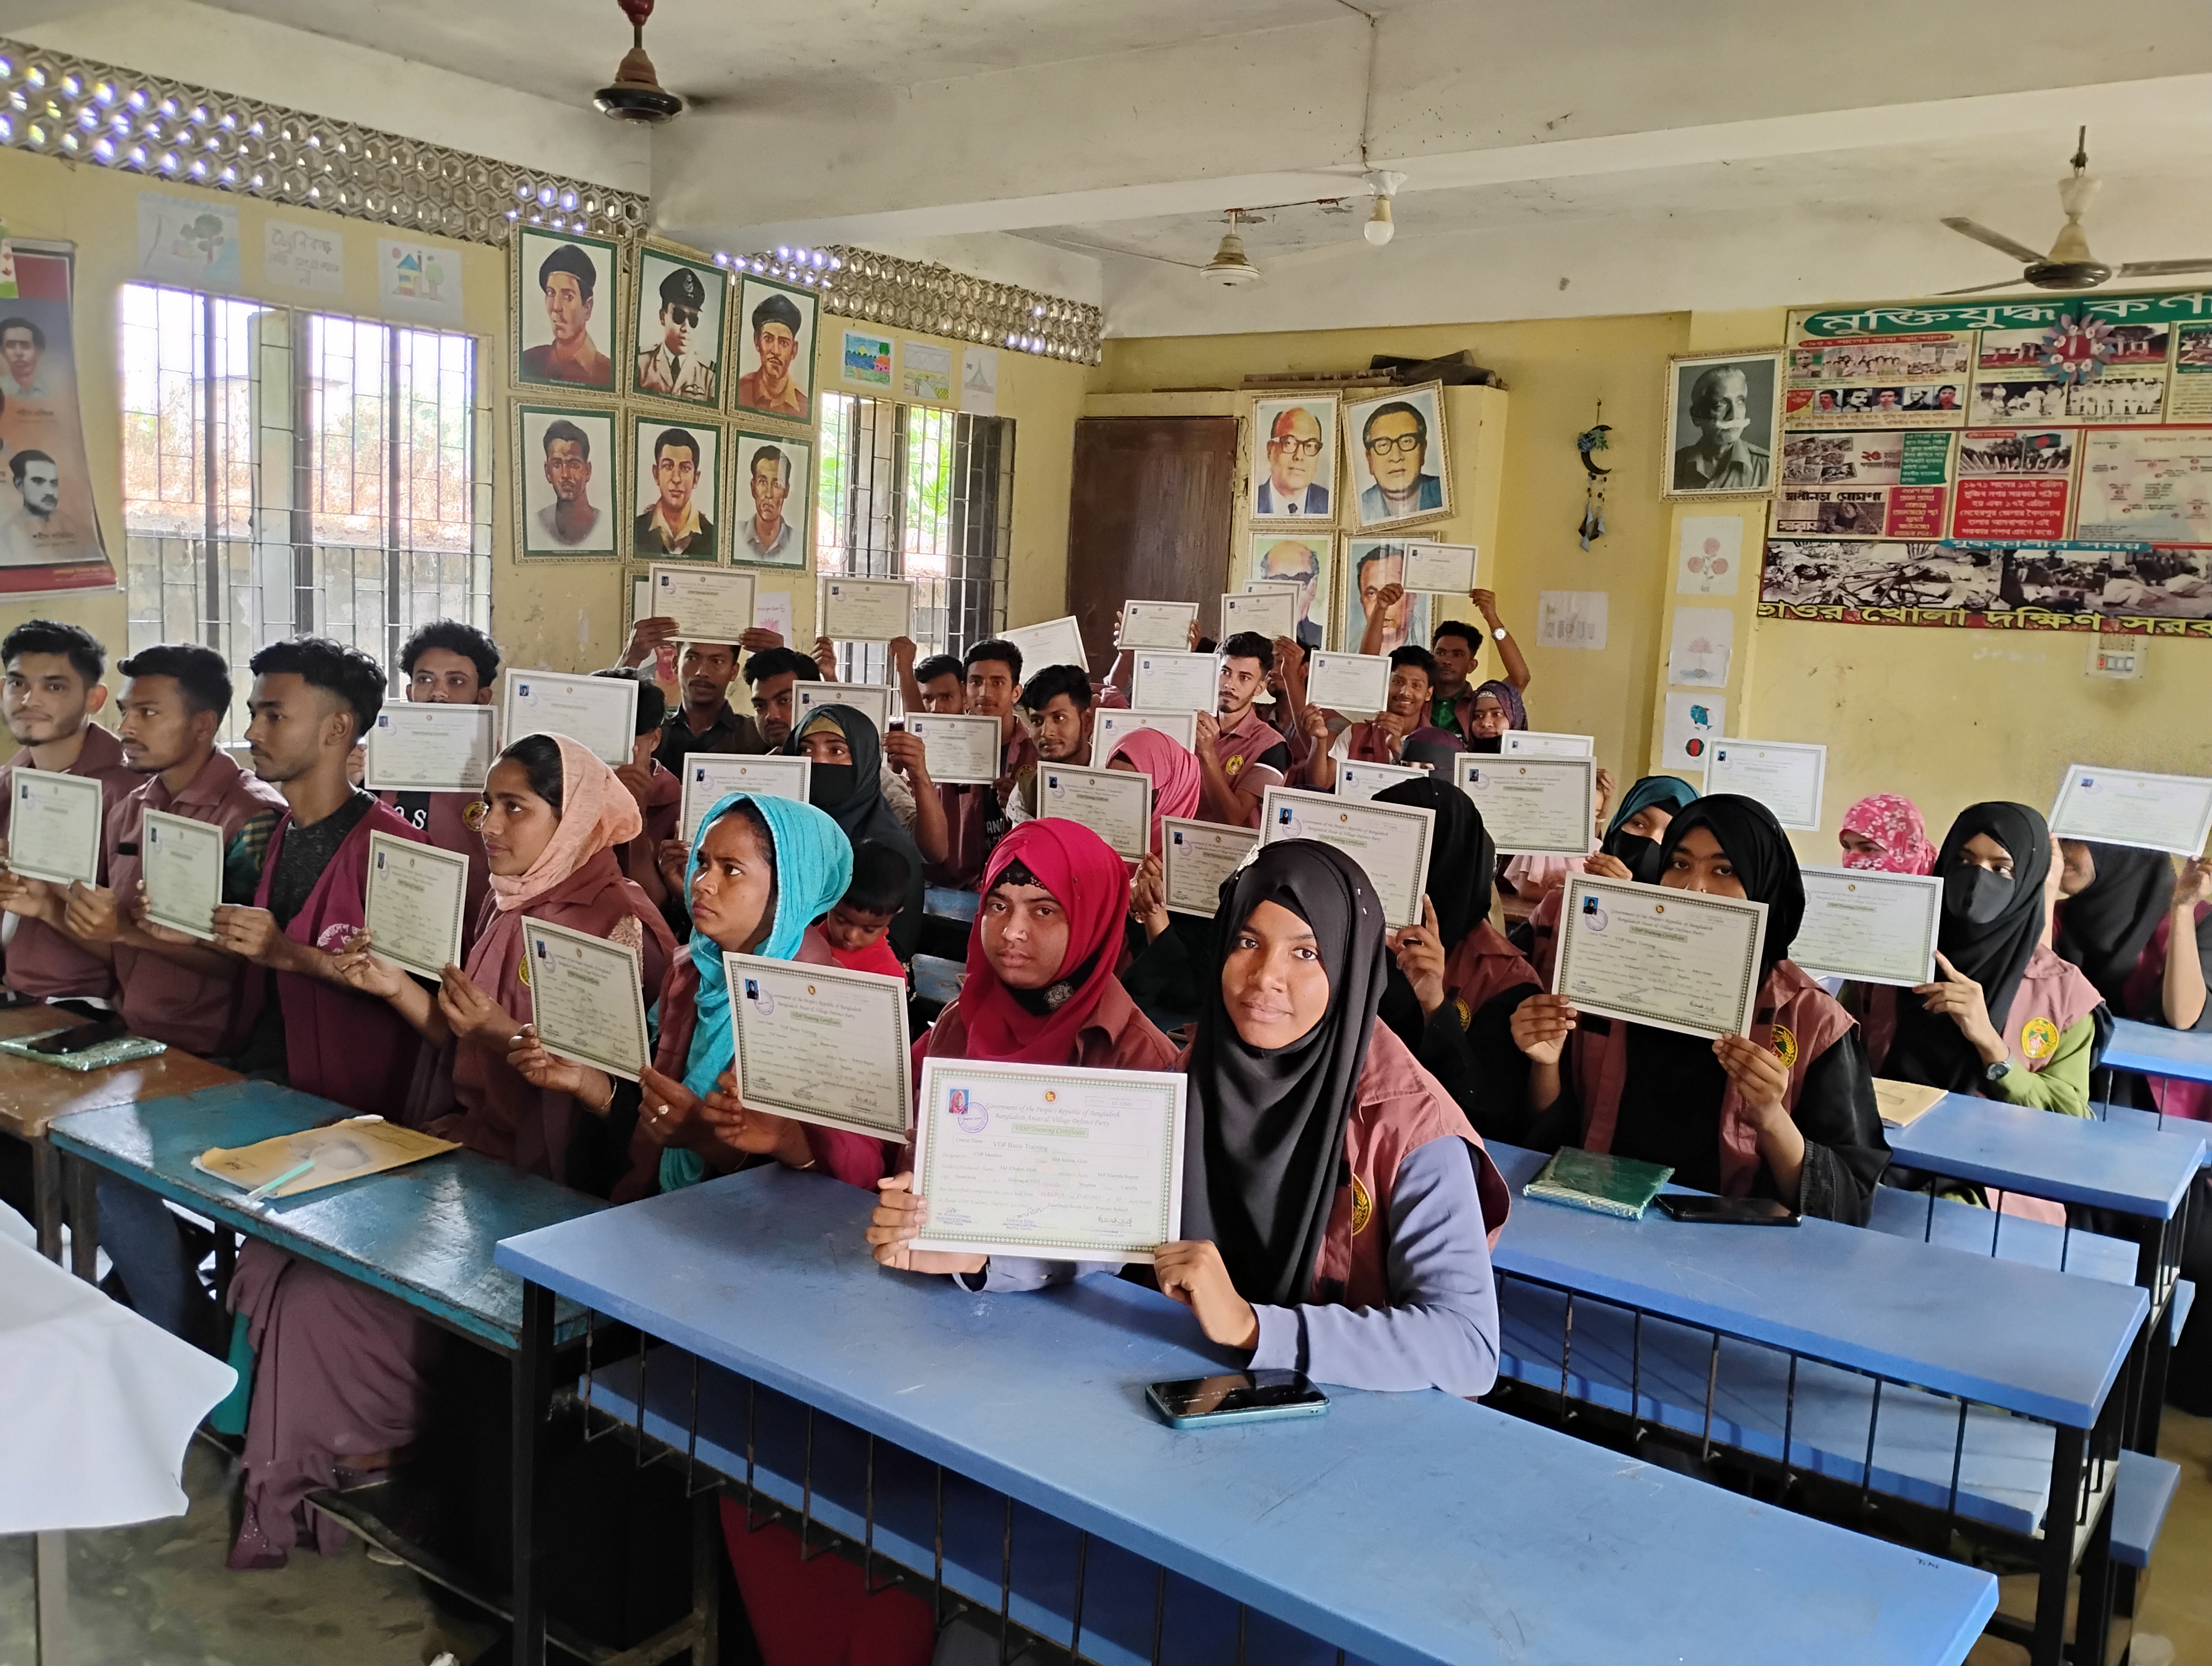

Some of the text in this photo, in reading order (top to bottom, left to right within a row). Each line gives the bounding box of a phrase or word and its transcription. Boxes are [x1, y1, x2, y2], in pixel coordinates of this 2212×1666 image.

[1814, 304, 2064, 335] মুক্তিযুদ্ধ
[1861, 605, 1971, 626] খোলা
[1983, 606, 2105, 631] দক্ষিণ
[986, 1103, 1018, 1111] Government
[1059, 1108, 1080, 1116] Republic
[995, 1113, 1025, 1121] Bangladesh
[1052, 1116, 1071, 1124] Village
[1072, 1118, 1093, 1126] Defence
[1031, 1126, 1054, 1135] Training
[1056, 1127, 1086, 1136] Certificate
[1025, 1143, 1048, 1152] Training
